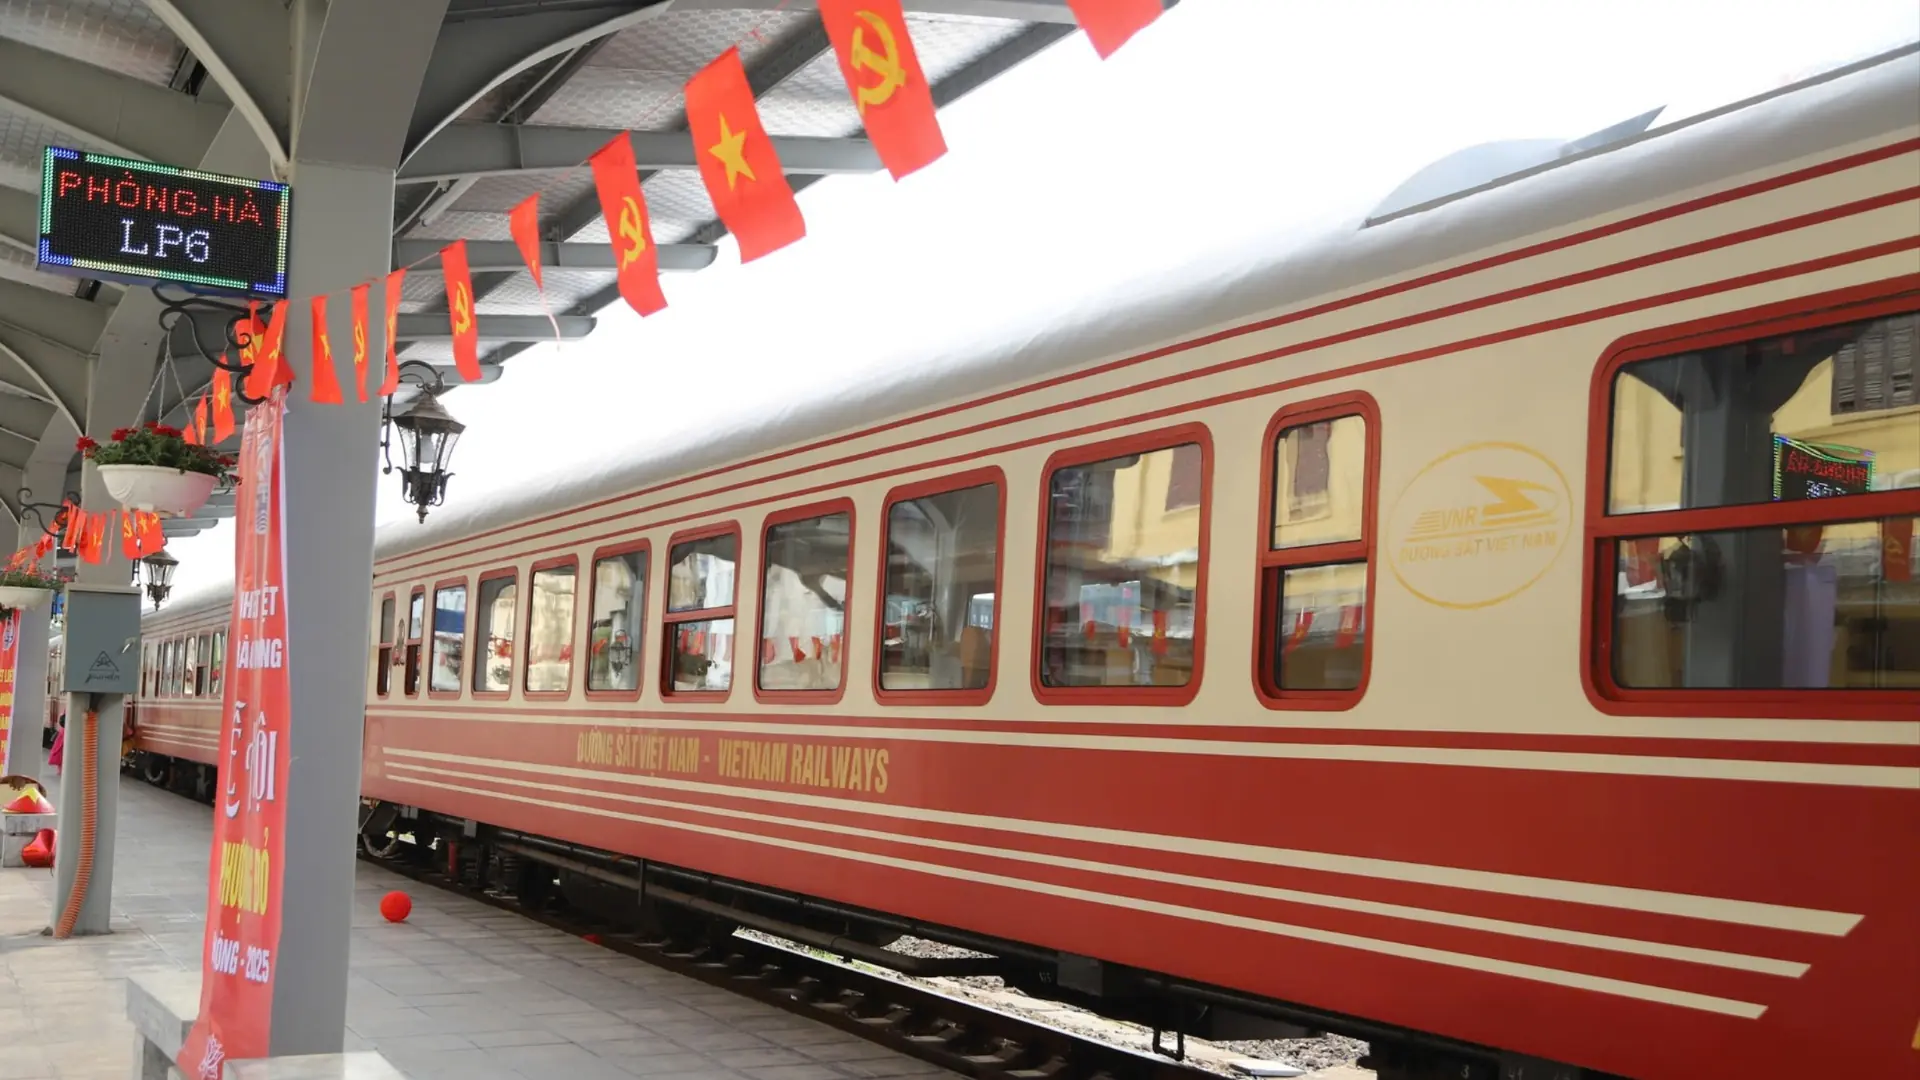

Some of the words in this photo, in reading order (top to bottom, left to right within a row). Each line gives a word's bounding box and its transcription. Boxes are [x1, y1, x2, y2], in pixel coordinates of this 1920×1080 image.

[59, 170, 263, 227] PHÒNG-HÀ
[119, 218, 211, 263] LP6
[1441, 506, 1478, 530] VNR
[667, 736, 700, 773] NAM
[718, 738, 788, 783] VIETNAM
[790, 743, 889, 794] RAILWAYS
